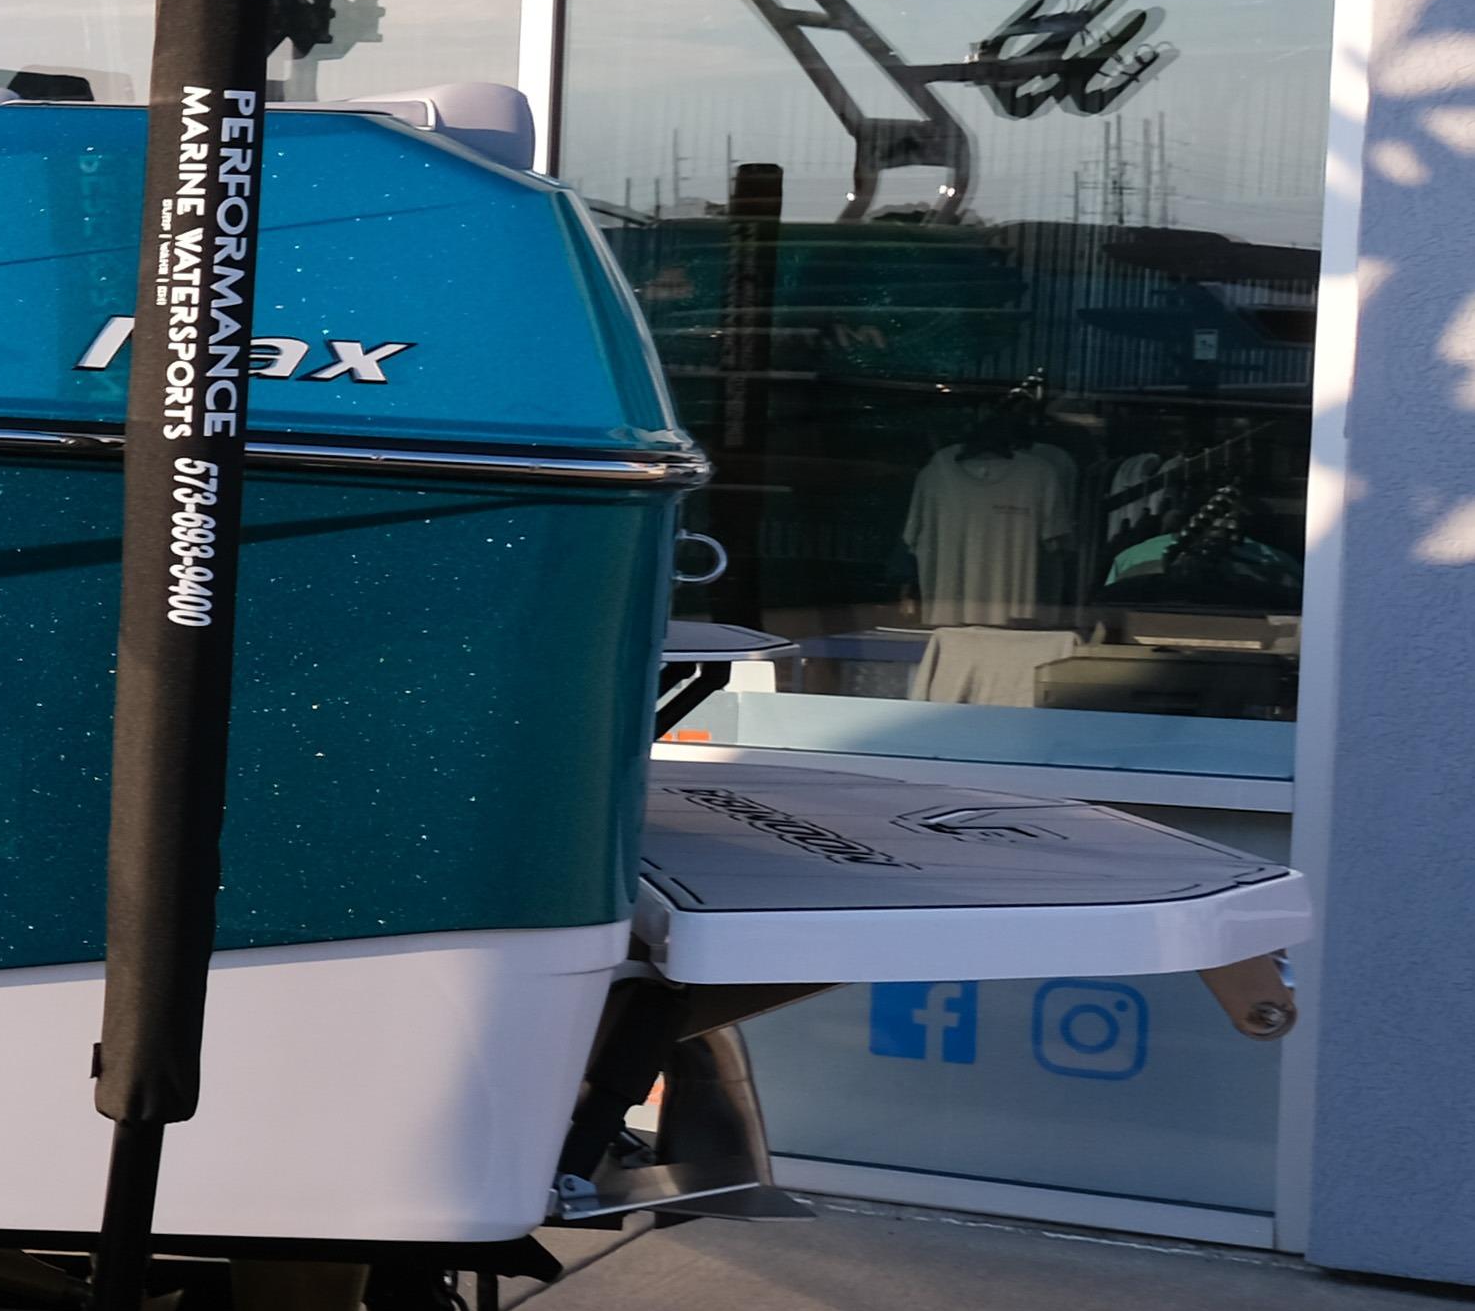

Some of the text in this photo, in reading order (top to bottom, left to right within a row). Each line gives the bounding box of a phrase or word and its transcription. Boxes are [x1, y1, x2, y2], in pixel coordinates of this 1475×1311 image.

[162, 85, 212, 441] MARINE WATERSPORTS
[204, 89, 257, 438] PERFORMANCE
[167, 457, 218, 628] 573-693-9400
